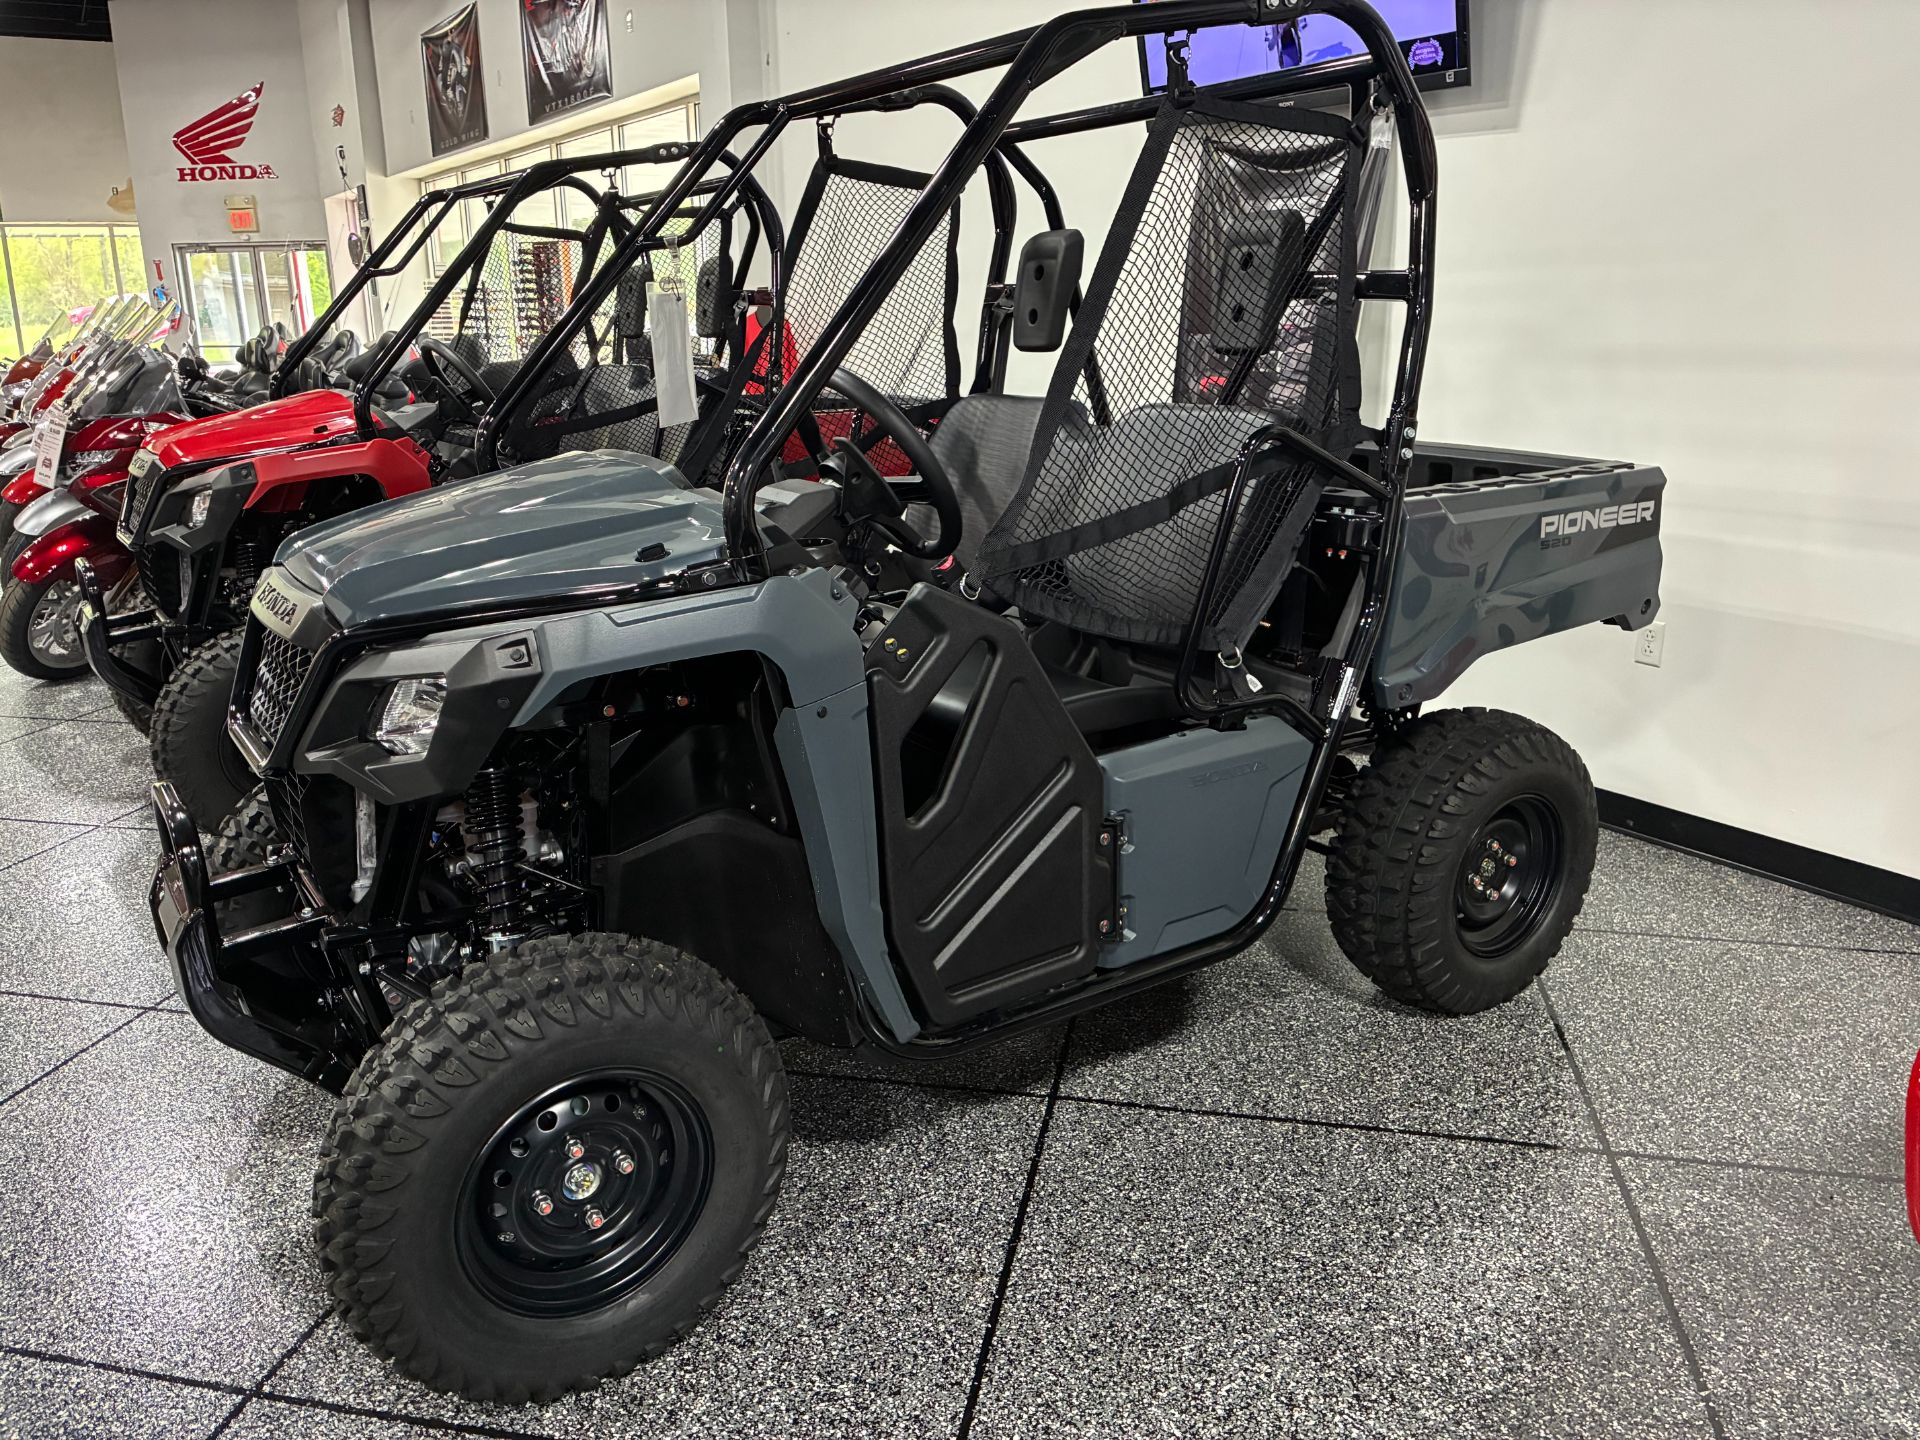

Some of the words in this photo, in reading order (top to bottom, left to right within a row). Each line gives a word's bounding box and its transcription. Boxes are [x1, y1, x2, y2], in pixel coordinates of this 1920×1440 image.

[176, 165, 279, 182] HONDA
[1540, 500, 1655, 539] PIONEER
[1540, 536, 1572, 550] 520
[256, 581, 299, 626] HONDA
